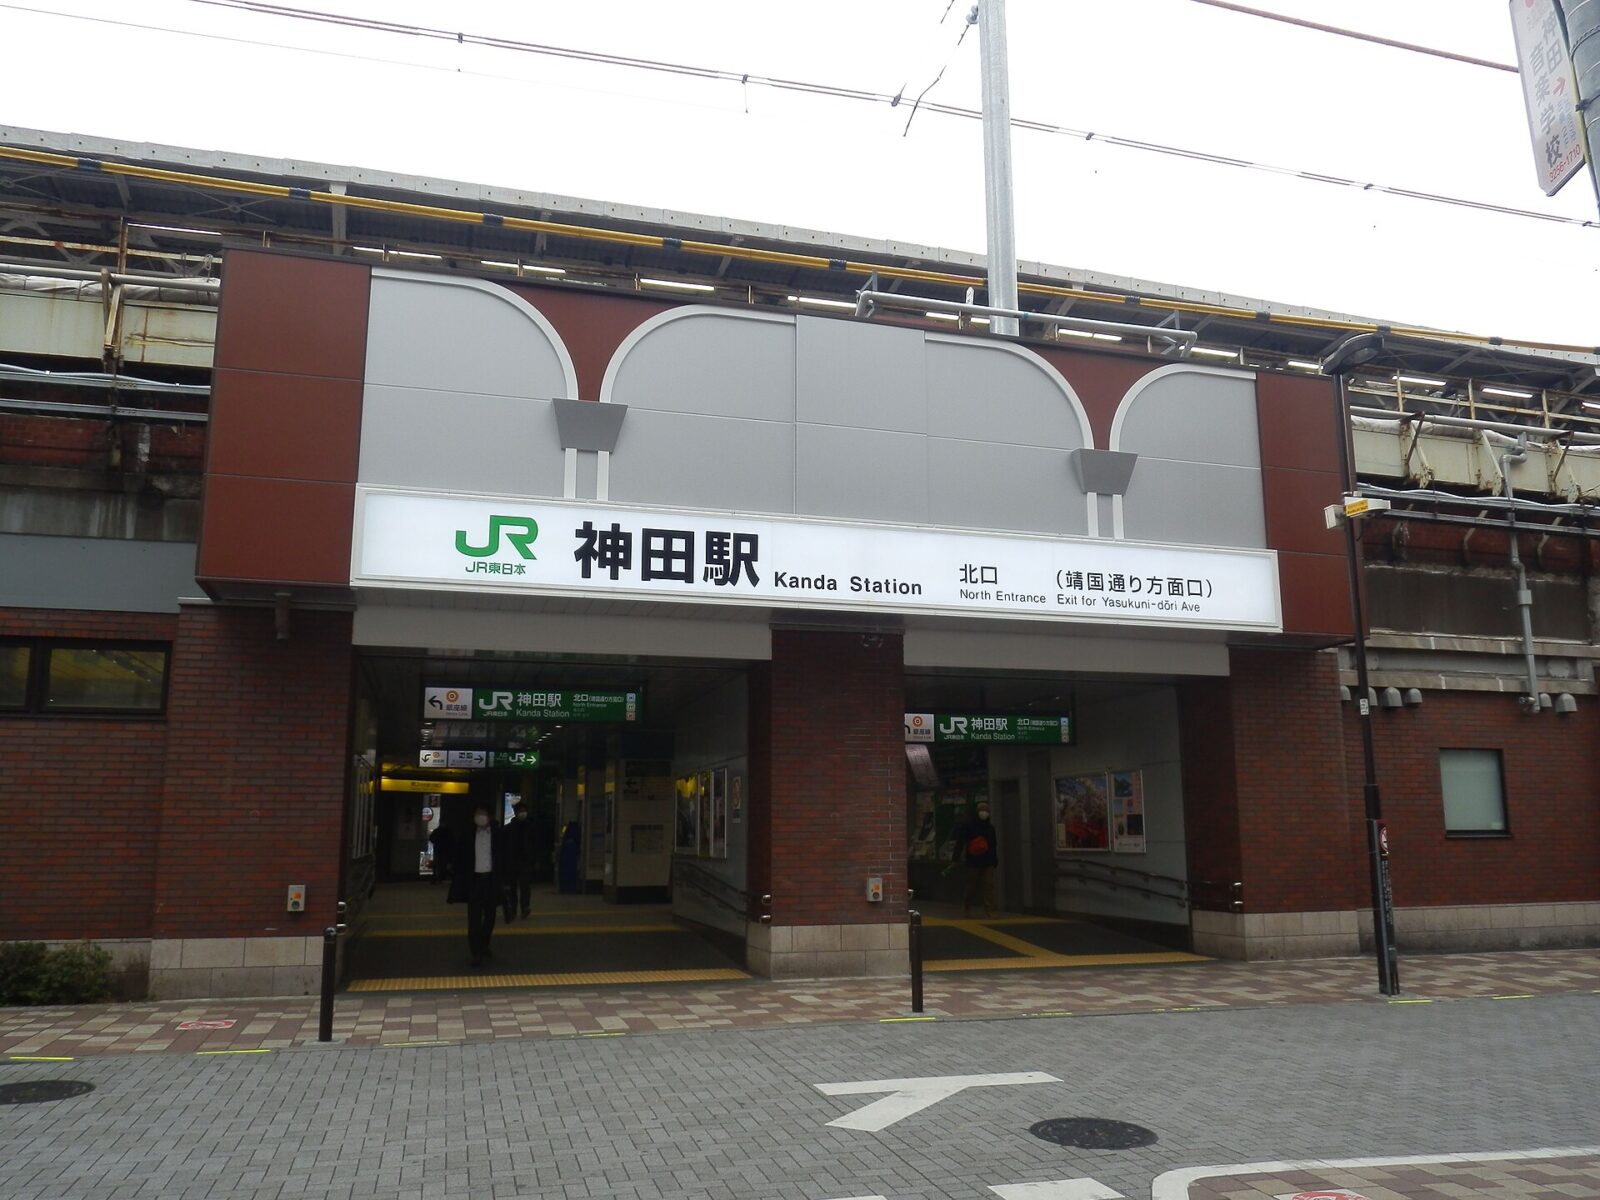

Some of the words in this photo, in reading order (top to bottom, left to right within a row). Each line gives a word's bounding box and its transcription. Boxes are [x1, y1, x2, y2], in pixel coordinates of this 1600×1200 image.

[455, 514, 538, 561] JR
[574, 521, 760, 588] 神田駅
[465, 561, 527, 576] JR東日本
[959, 563, 998, 585] 北口
[774, 571, 838, 591] Kanda
[850, 576, 922, 595] Station
[959, 588, 992, 601] North
[996, 590, 1047, 605] Entrance
[1057, 593, 1078, 606] Exit
[1081, 594, 1096, 607] for
[1101, 596, 1178, 611] Yasukuni-dōri
[1181, 600, 1201, 613] Ave
[479, 691, 513, 711] JR
[517, 692, 562, 707] 神田駅
[516, 709, 541, 718] Kanda
[543, 708, 570, 718] Station
[940, 716, 968, 734] JR
[971, 717, 1008, 731] 神田駅
[971, 732, 992, 740] Kanda
[993, 733, 1015, 741] Station
[509, 752, 526, 763] JR
